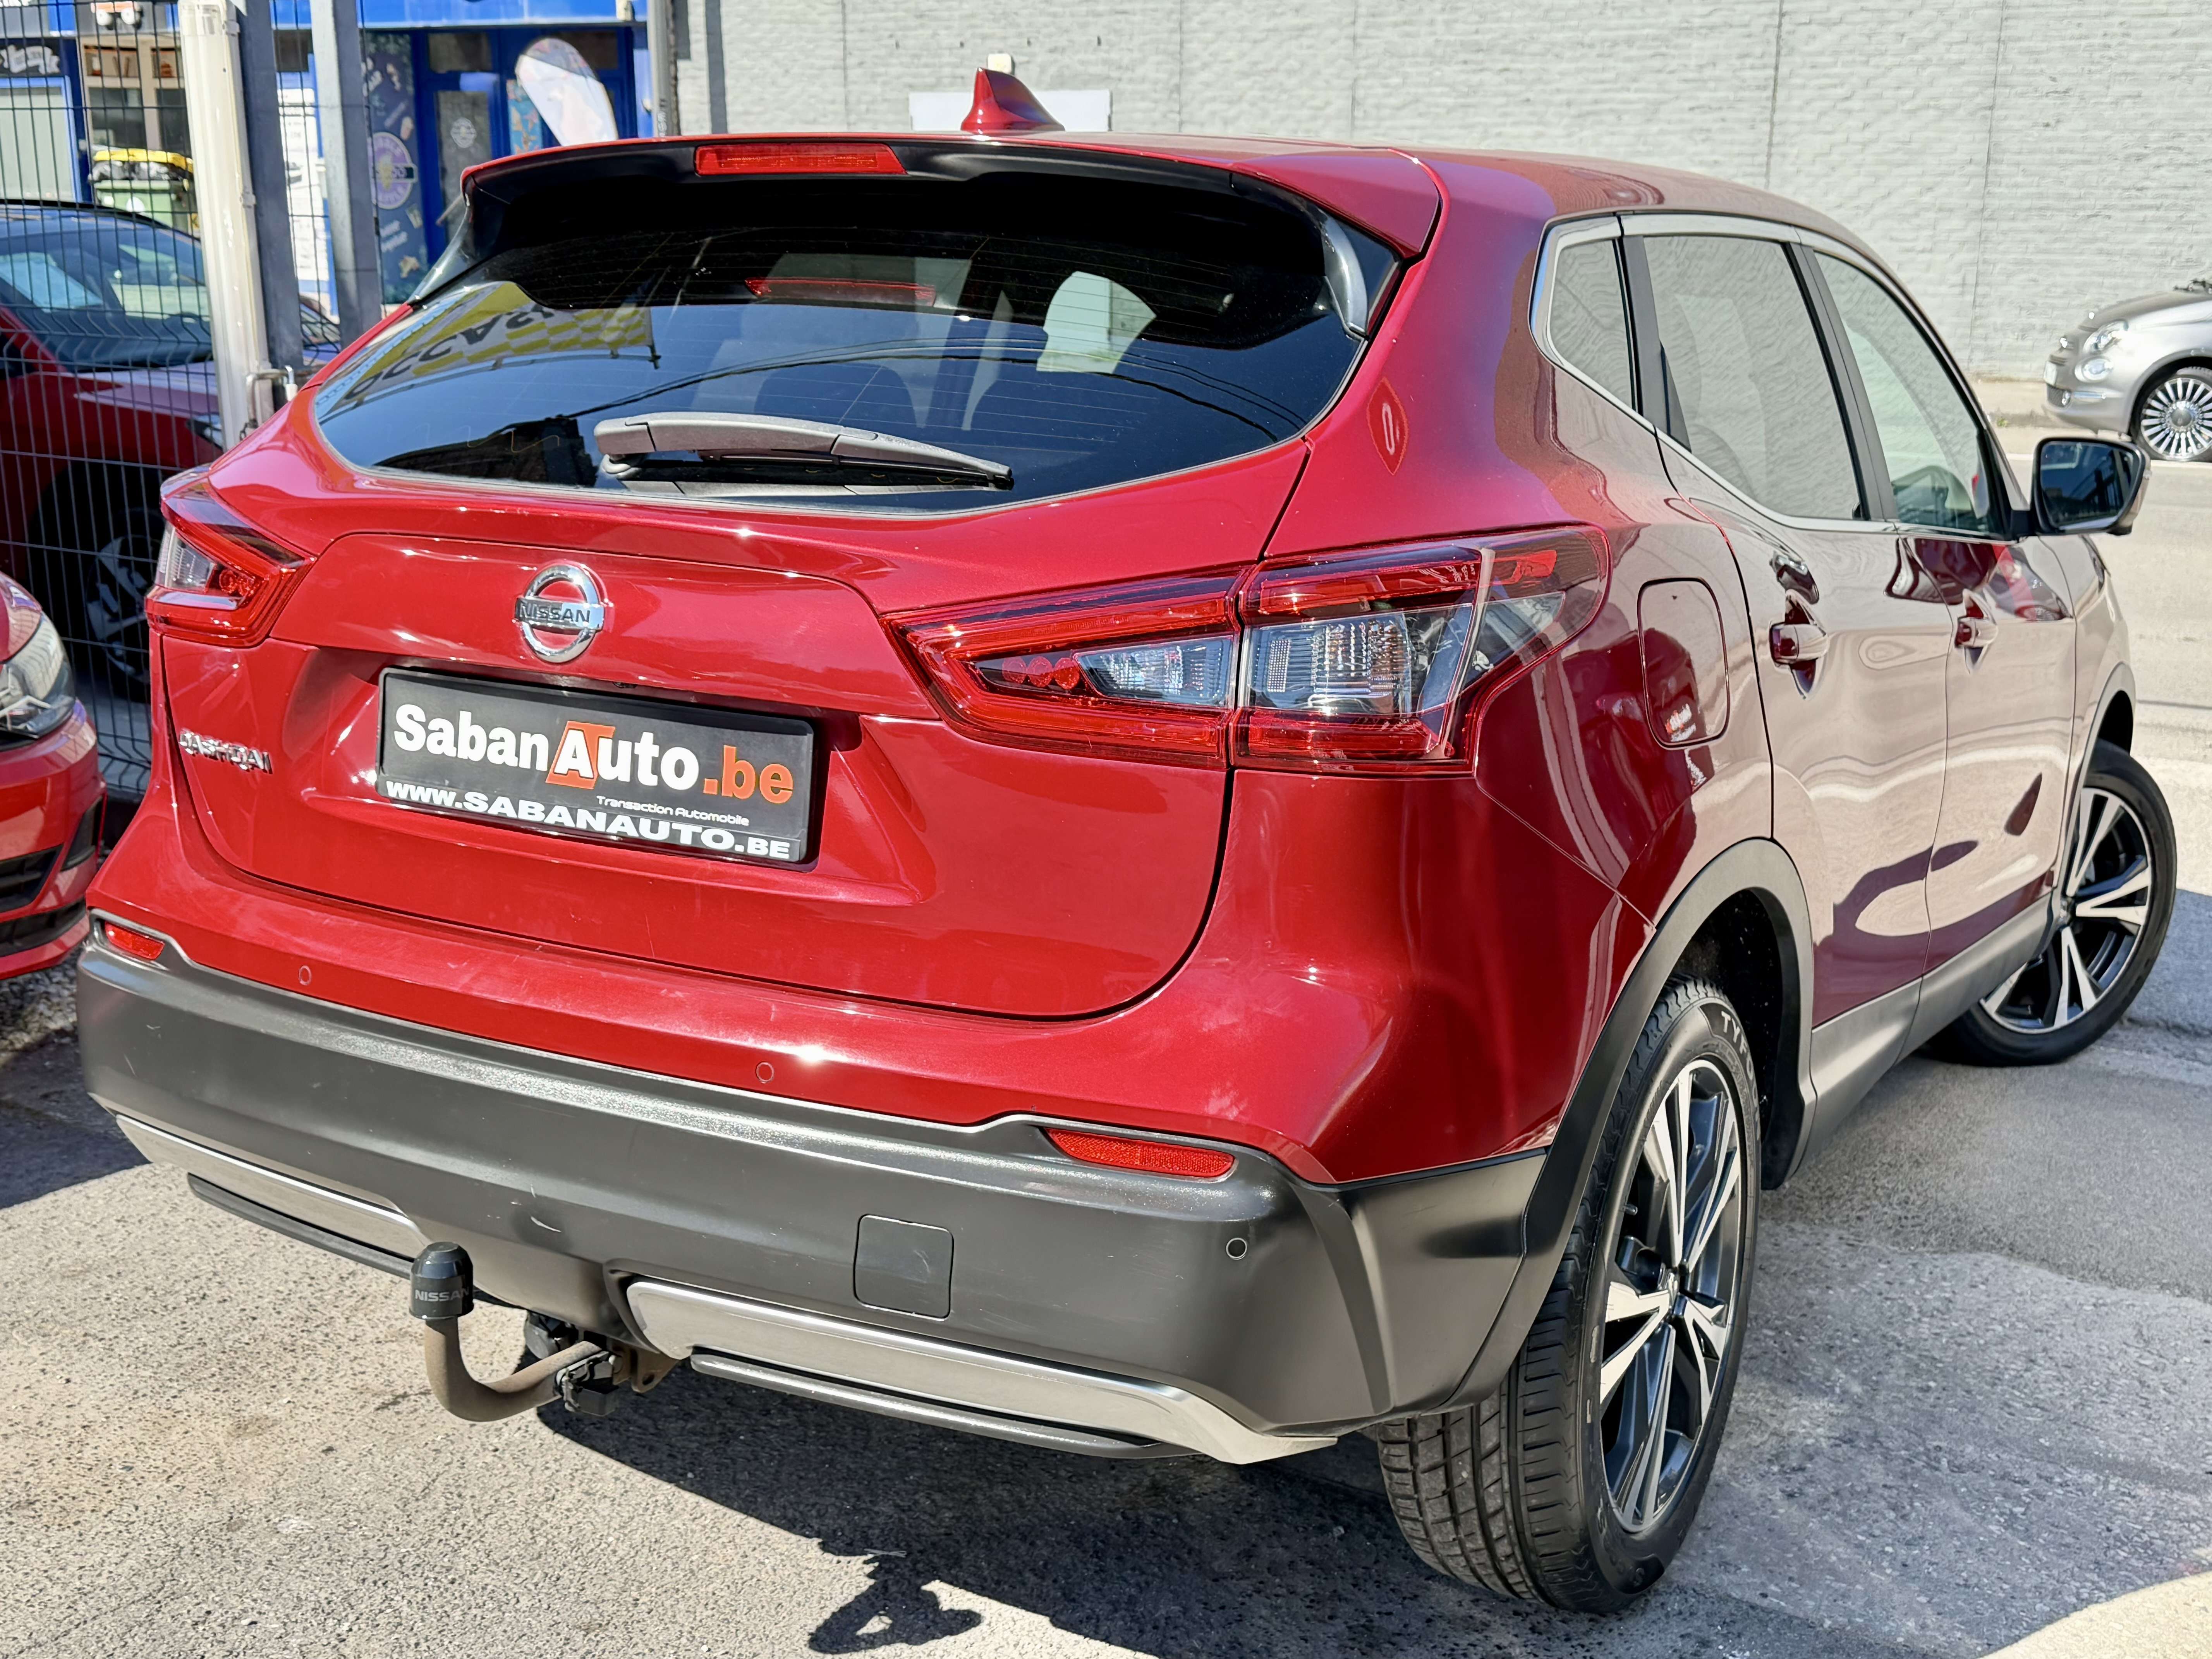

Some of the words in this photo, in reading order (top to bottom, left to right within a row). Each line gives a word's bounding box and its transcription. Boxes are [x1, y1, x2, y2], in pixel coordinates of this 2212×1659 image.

[519, 601, 591, 623] NISSAN
[394, 704, 793, 804] SabanAuto.be
[596, 795, 673, 815] Transaction
[675, 807, 750, 826] Automobile
[415, 1287, 469, 1302] NISSAN
